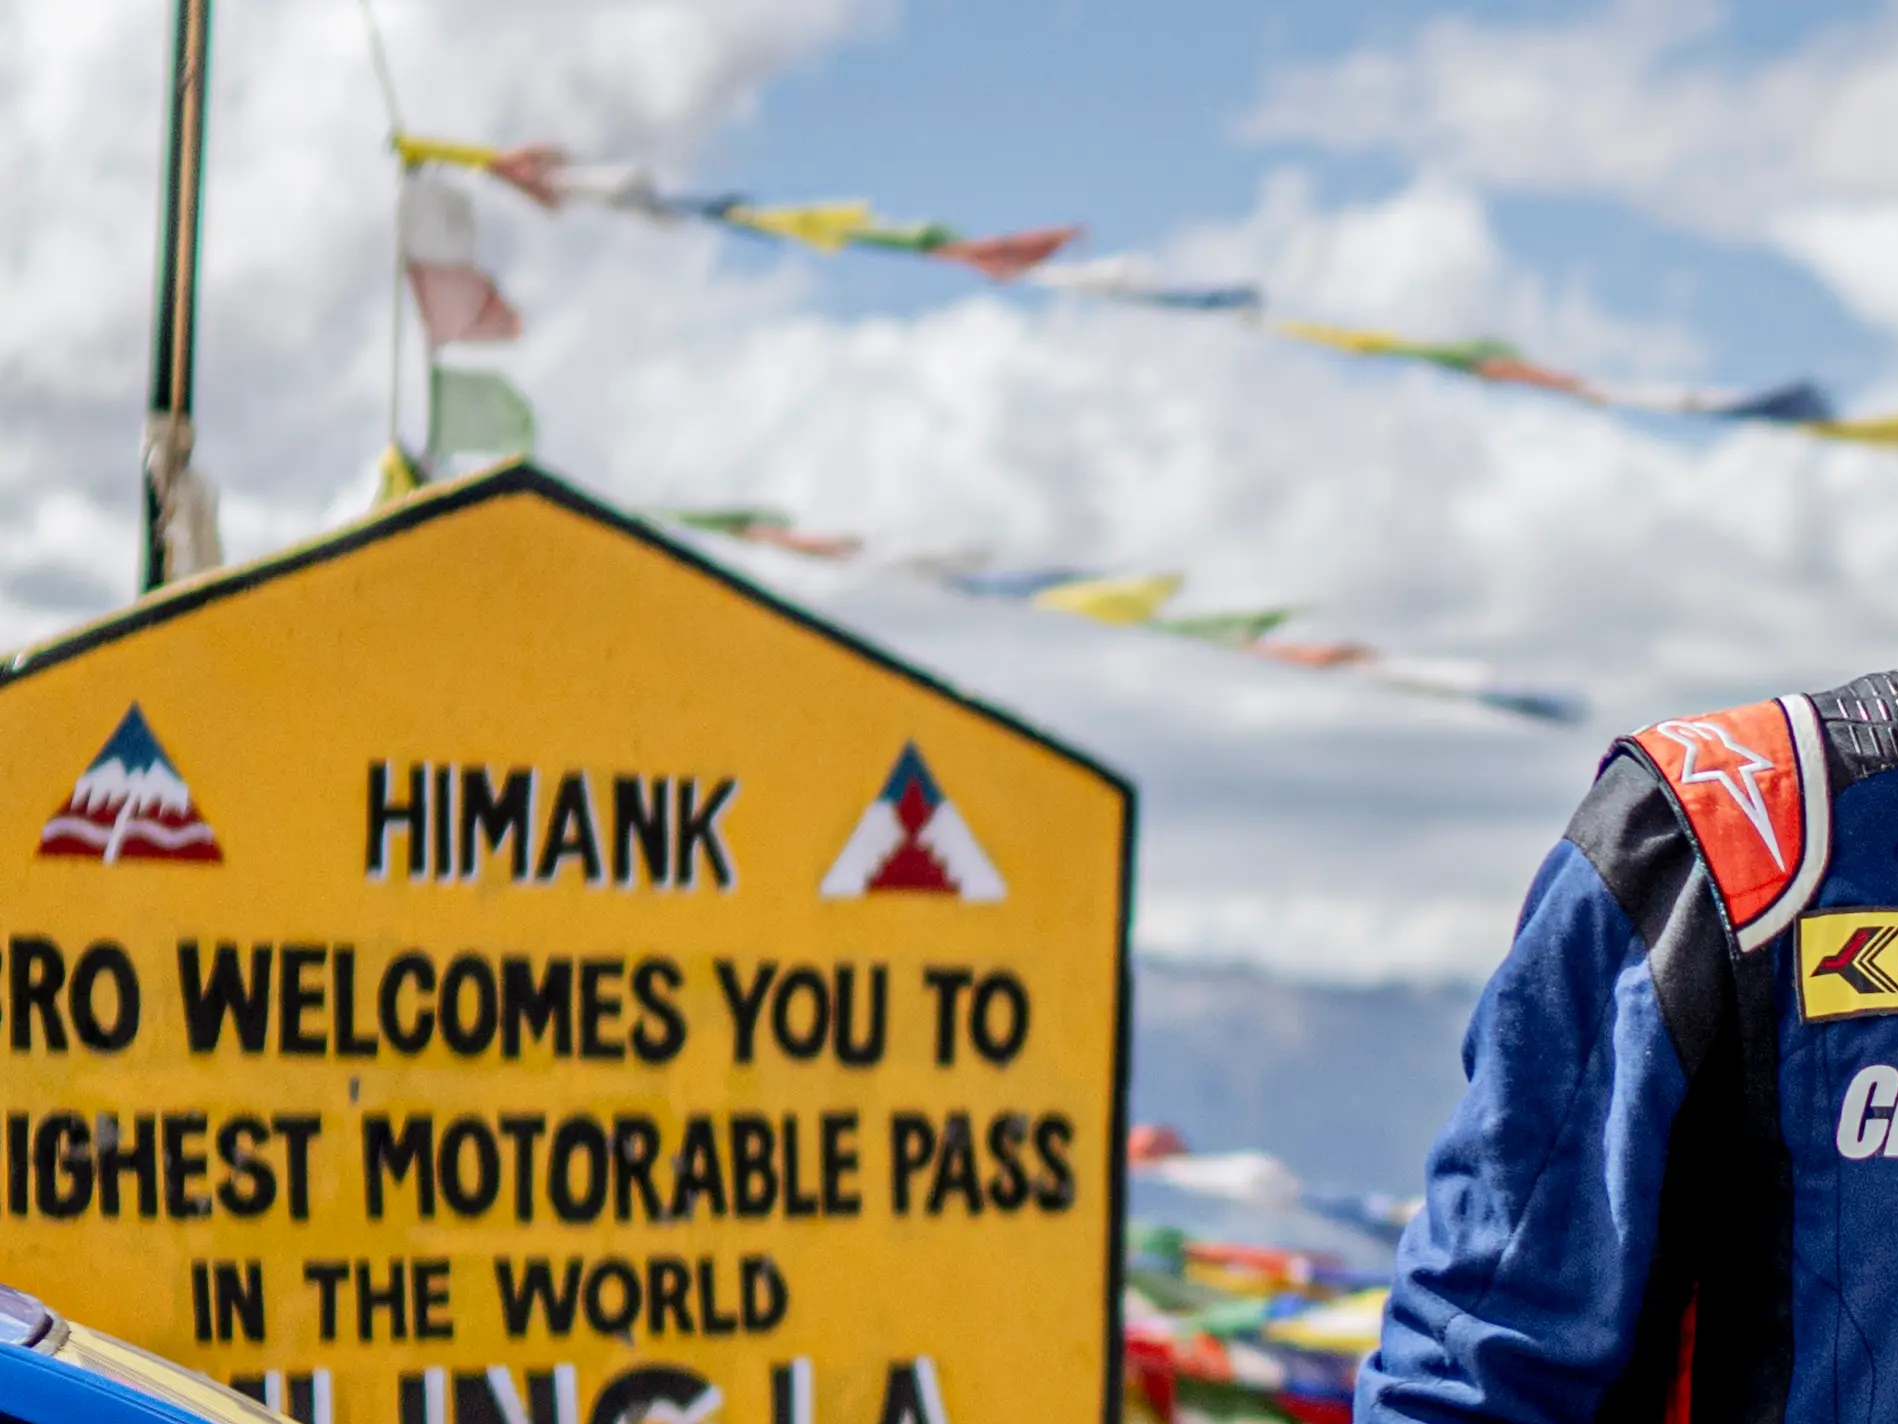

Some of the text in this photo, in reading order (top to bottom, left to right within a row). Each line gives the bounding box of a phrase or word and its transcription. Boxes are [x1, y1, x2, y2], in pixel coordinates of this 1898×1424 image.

[365, 759, 740, 892] HIMANK
[0, 934, 1033, 1068] RO WELCOMES YOU TO
[0, 1110, 1078, 1227] IGHEST MOTORABLE PASS
[191, 1254, 792, 1346] IN THE WORLD
